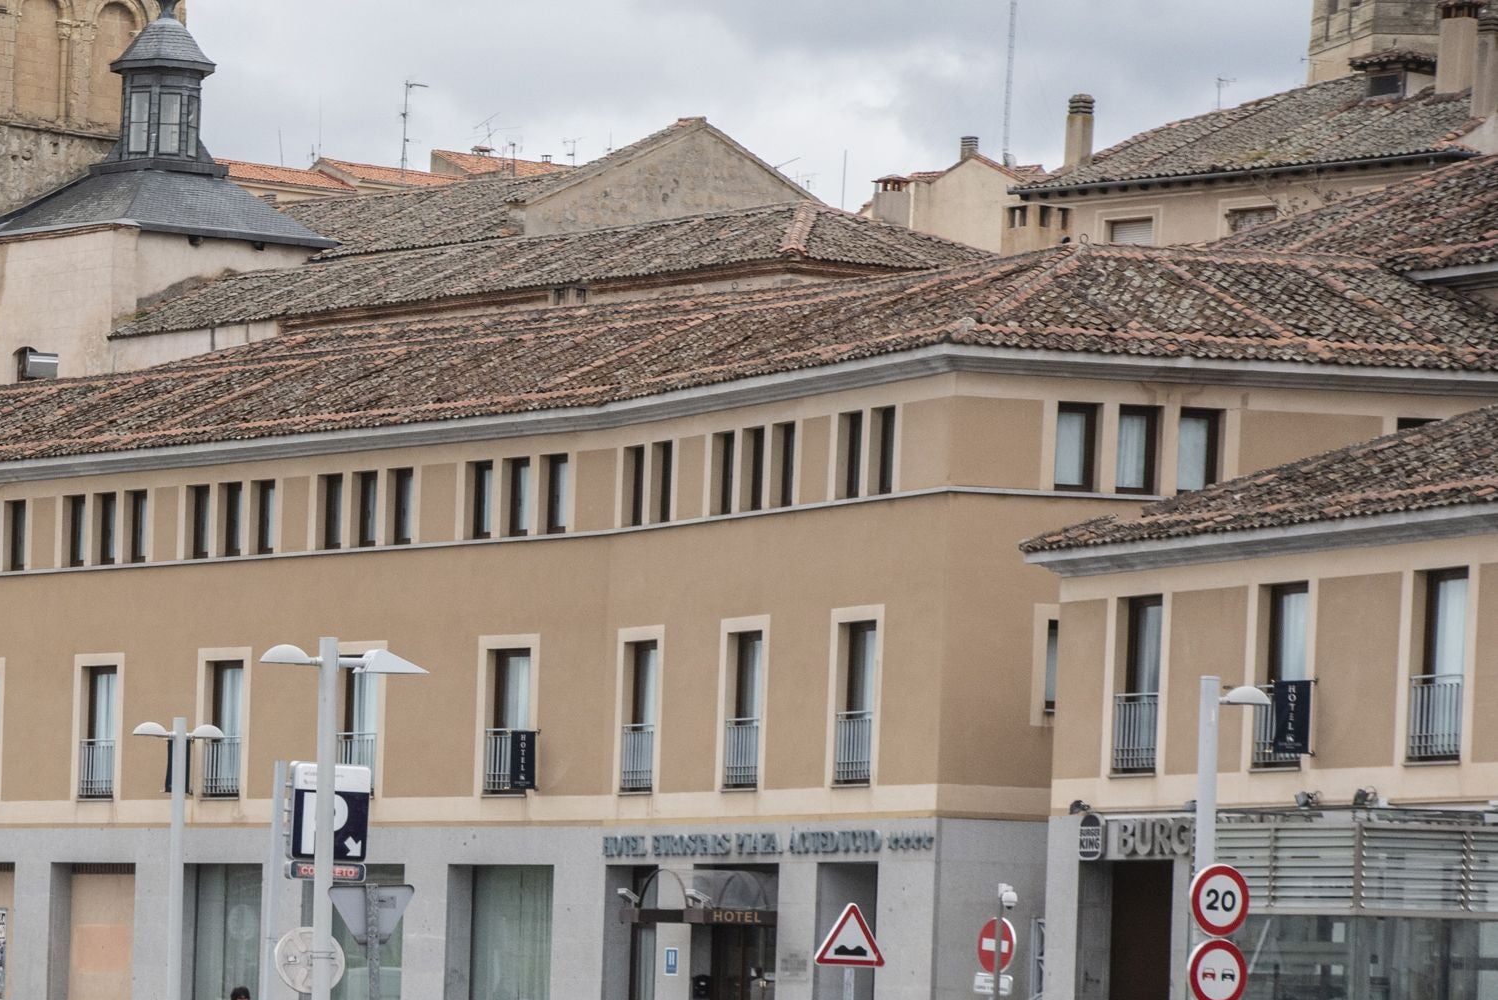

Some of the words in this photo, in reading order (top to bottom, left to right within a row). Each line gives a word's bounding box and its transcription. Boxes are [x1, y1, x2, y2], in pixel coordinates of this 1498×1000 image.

[1288, 685, 1297, 730] HOTEL
[301, 791, 349, 855] P
[1080, 828, 1100, 837] BURGER
[604, 836, 647, 857] HOTEL
[653, 834, 731, 856] EUROSTARS
[735, 833, 783, 855] PLAZA
[789, 830, 882, 854] ACUEDUCTO
[1079, 838, 1100, 850] KING
[1118, 818, 1194, 856] BURG
[300, 865, 356, 878] COETO
[1206, 889, 1236, 912] 20
[713, 911, 762, 923] HOTEL
